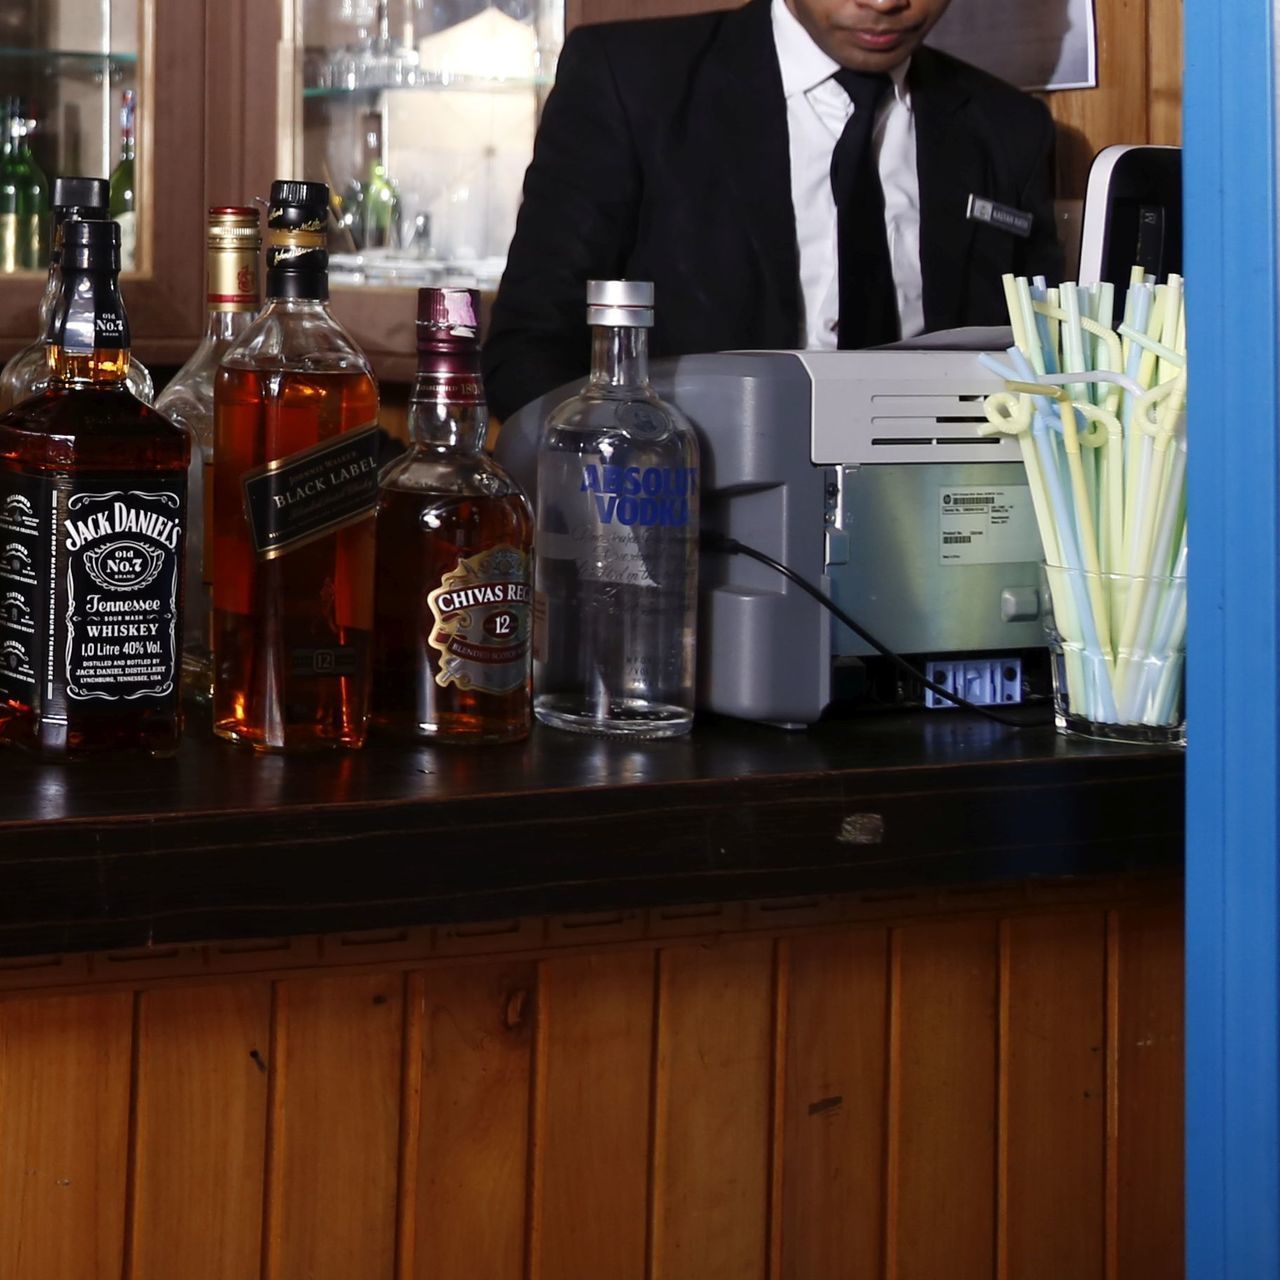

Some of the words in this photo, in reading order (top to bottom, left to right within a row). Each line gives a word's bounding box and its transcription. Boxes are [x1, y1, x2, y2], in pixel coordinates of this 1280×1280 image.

[96, 319, 124, 332] No.7
[272, 479, 327, 510] BLACK
[329, 455, 378, 486] LABEL
[579, 463, 699, 497] ABSOLUT
[594, 495, 689, 528] VODKA
[63, 511, 113, 551] JACK
[113, 502, 182, 549] DANIEL'S
[115, 550, 134, 558] Old
[106, 558, 143, 573] No.7
[50, 580, 56, 589] IN
[85, 594, 161, 613] Tennessee
[438, 584, 504, 613] CHIVAS
[86, 623, 159, 638] WHISKEY
[495, 614, 511, 635] 12
[97, 642, 120, 656] Litre
[122, 640, 144, 655] 40%
[146, 640, 163, 654] Vol.
[47, 637, 55, 680] TENNESSEE
[317, 654, 331, 668] 12
[125, 666, 167, 674] DISTILLERY
